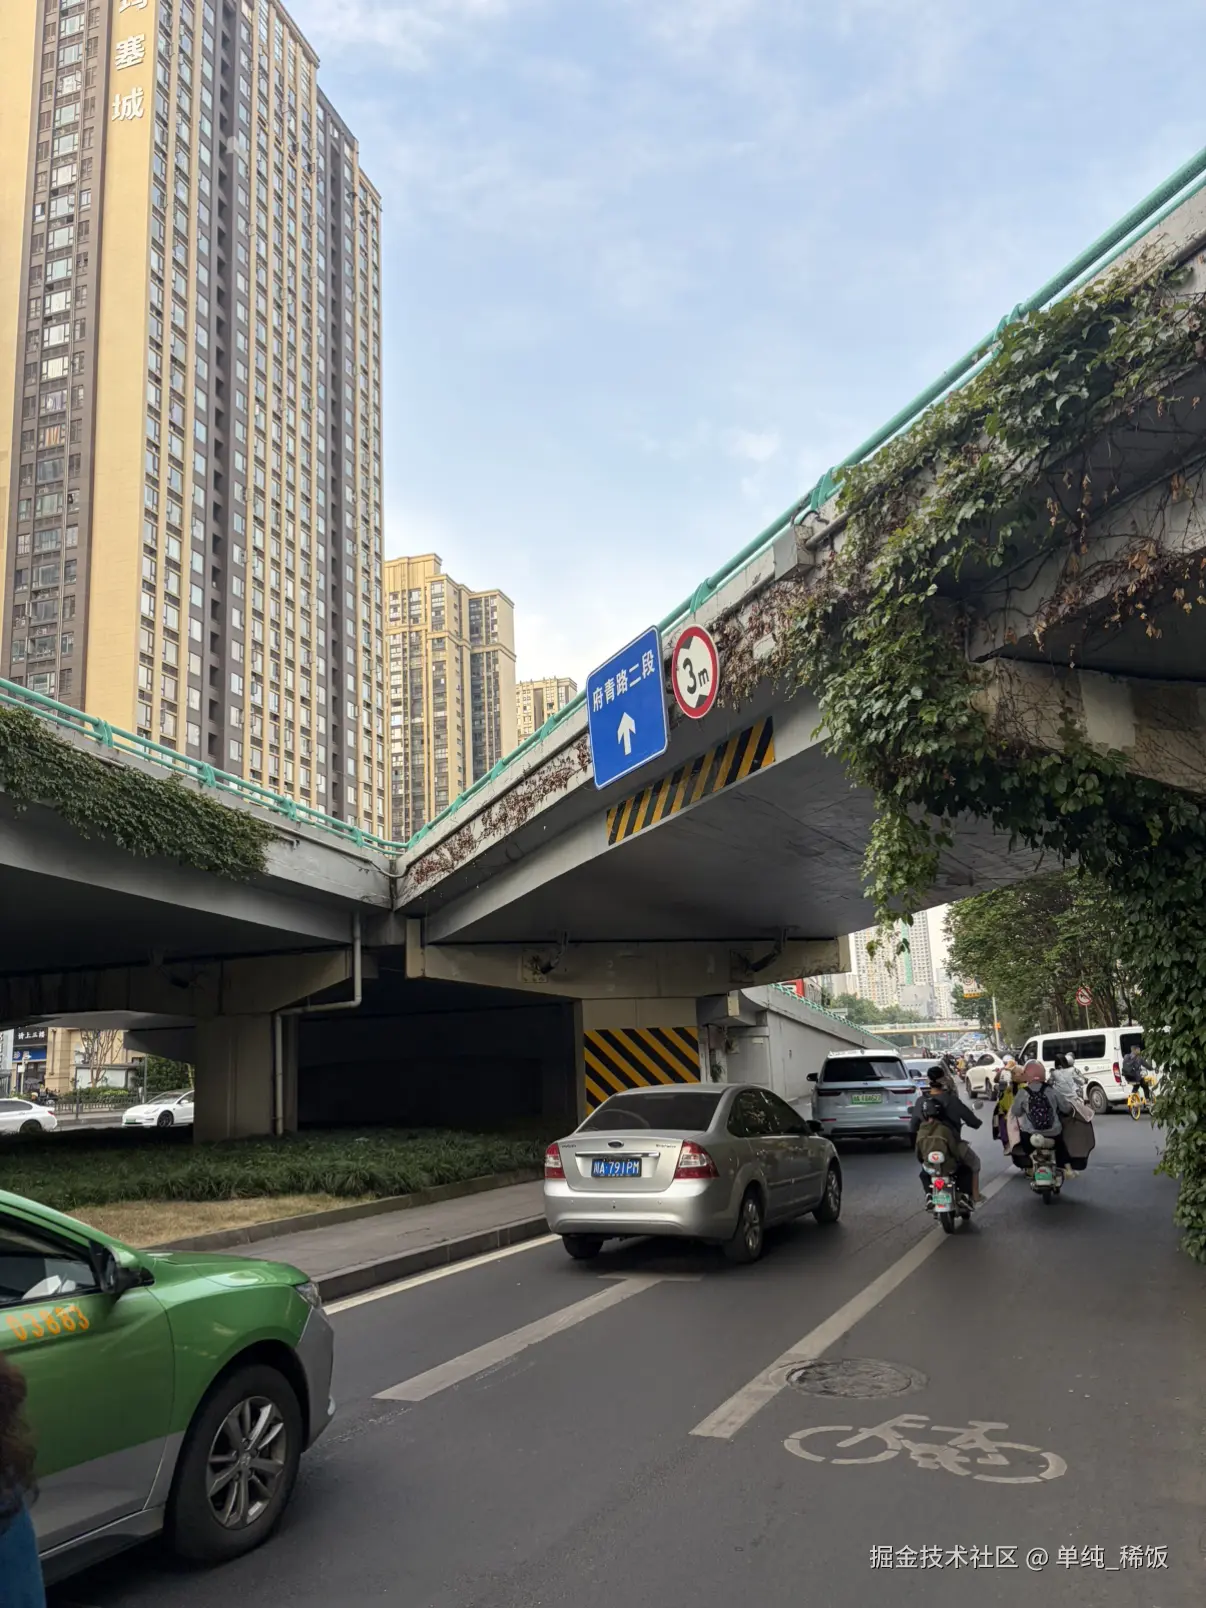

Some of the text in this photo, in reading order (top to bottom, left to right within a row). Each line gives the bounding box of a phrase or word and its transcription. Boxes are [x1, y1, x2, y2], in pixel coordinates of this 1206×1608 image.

[592, 649, 656, 713] 府青路二段
